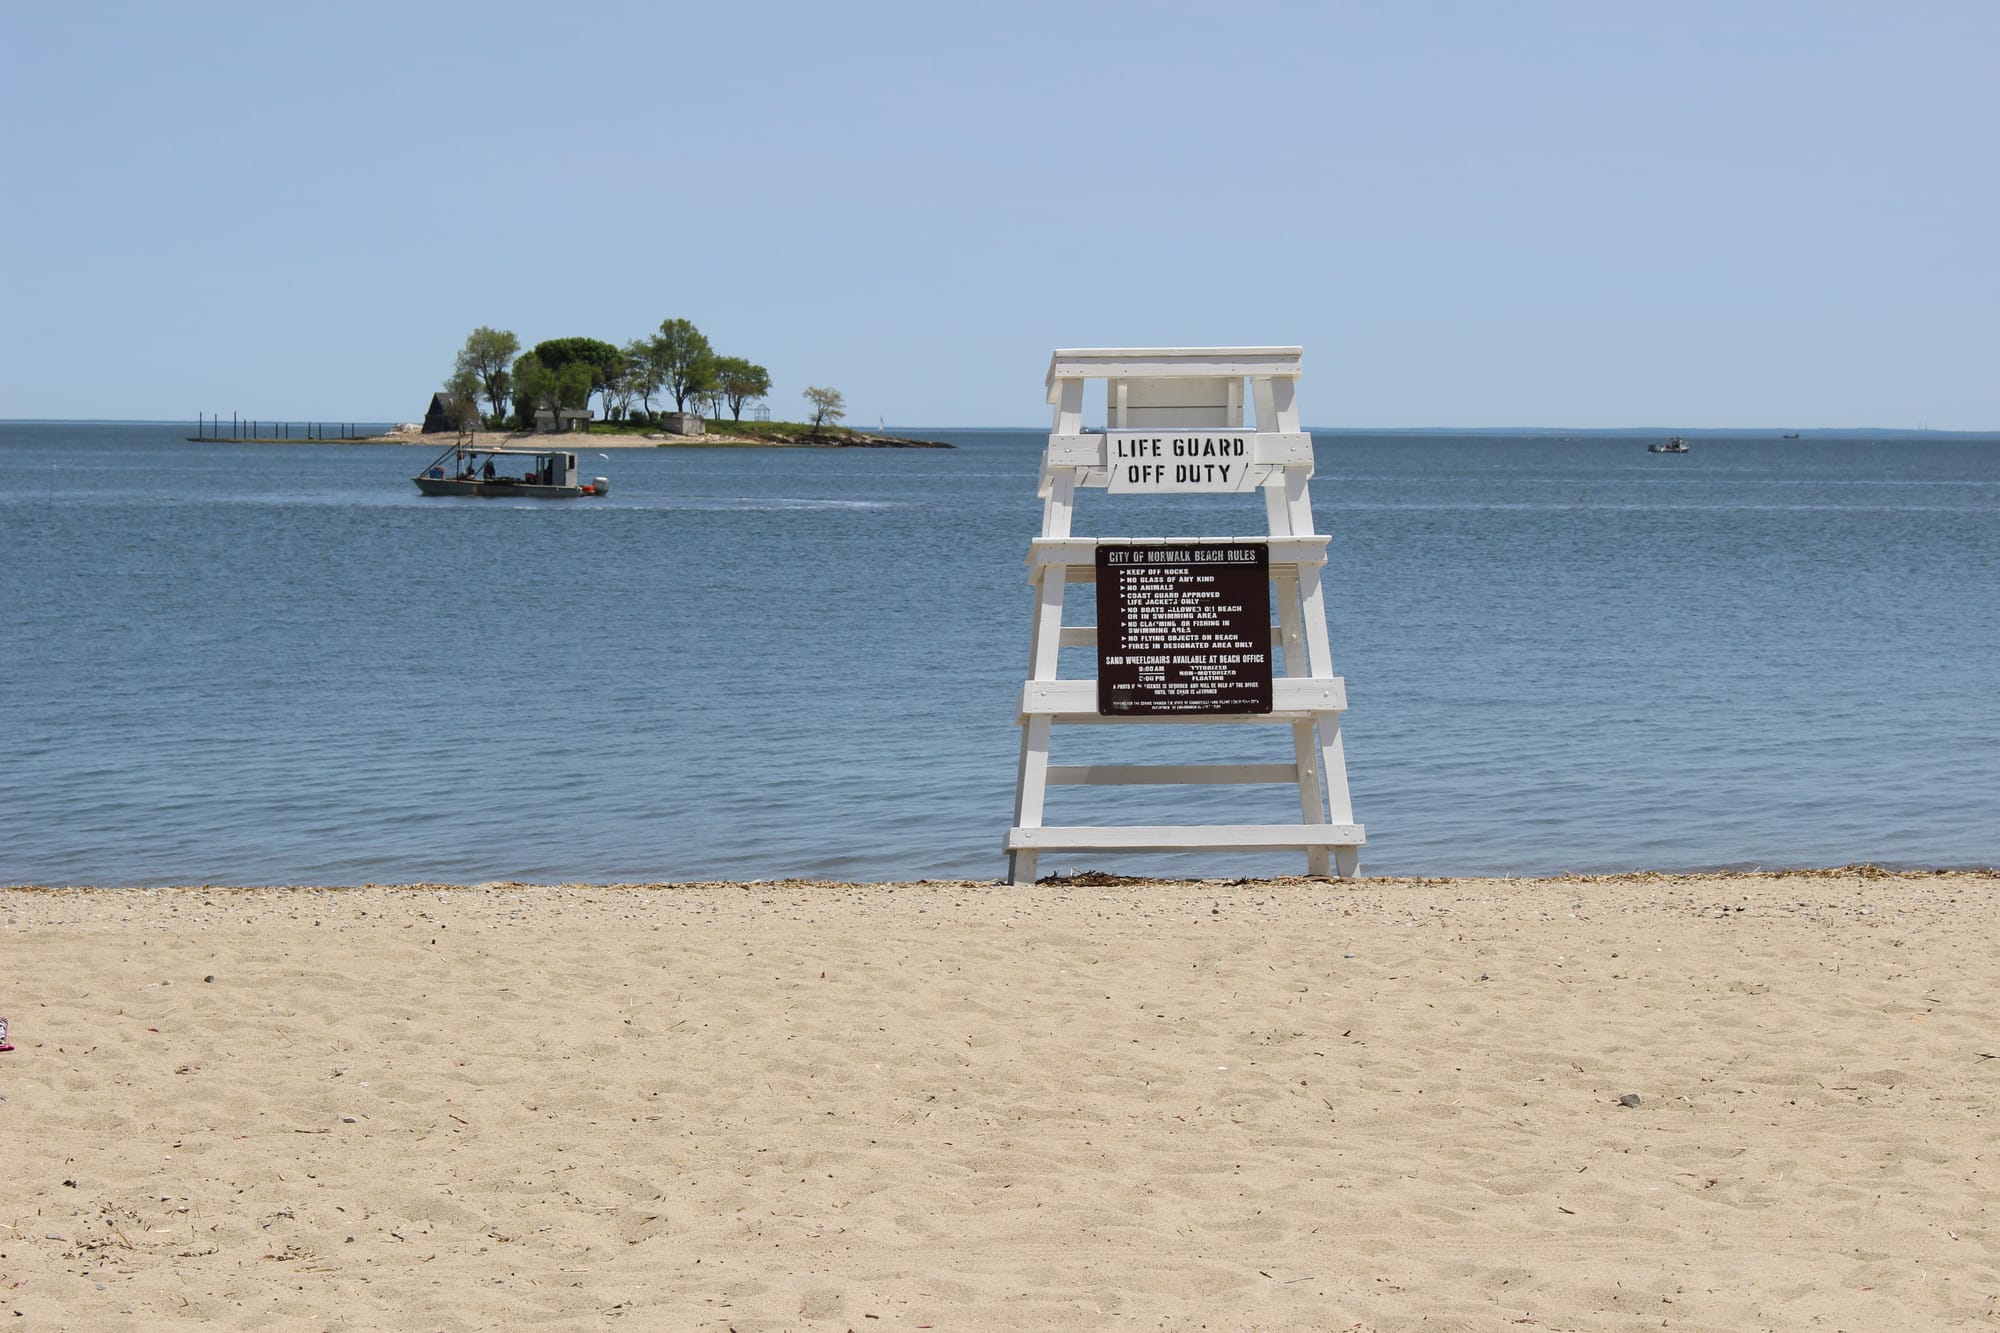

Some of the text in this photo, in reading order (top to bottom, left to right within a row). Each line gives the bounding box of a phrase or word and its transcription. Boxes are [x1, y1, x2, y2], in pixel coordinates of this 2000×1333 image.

[1118, 438, 1244, 457] LIFE GUARD
[1128, 464, 1231, 483] OFF DUTY
[1109, 550, 1255, 563] CITY OF NORWALK BEACH RULES
[1106, 655, 1264, 665] SAND WHEELCHAIRS AVAILABLE AT BEACH OFFICE
